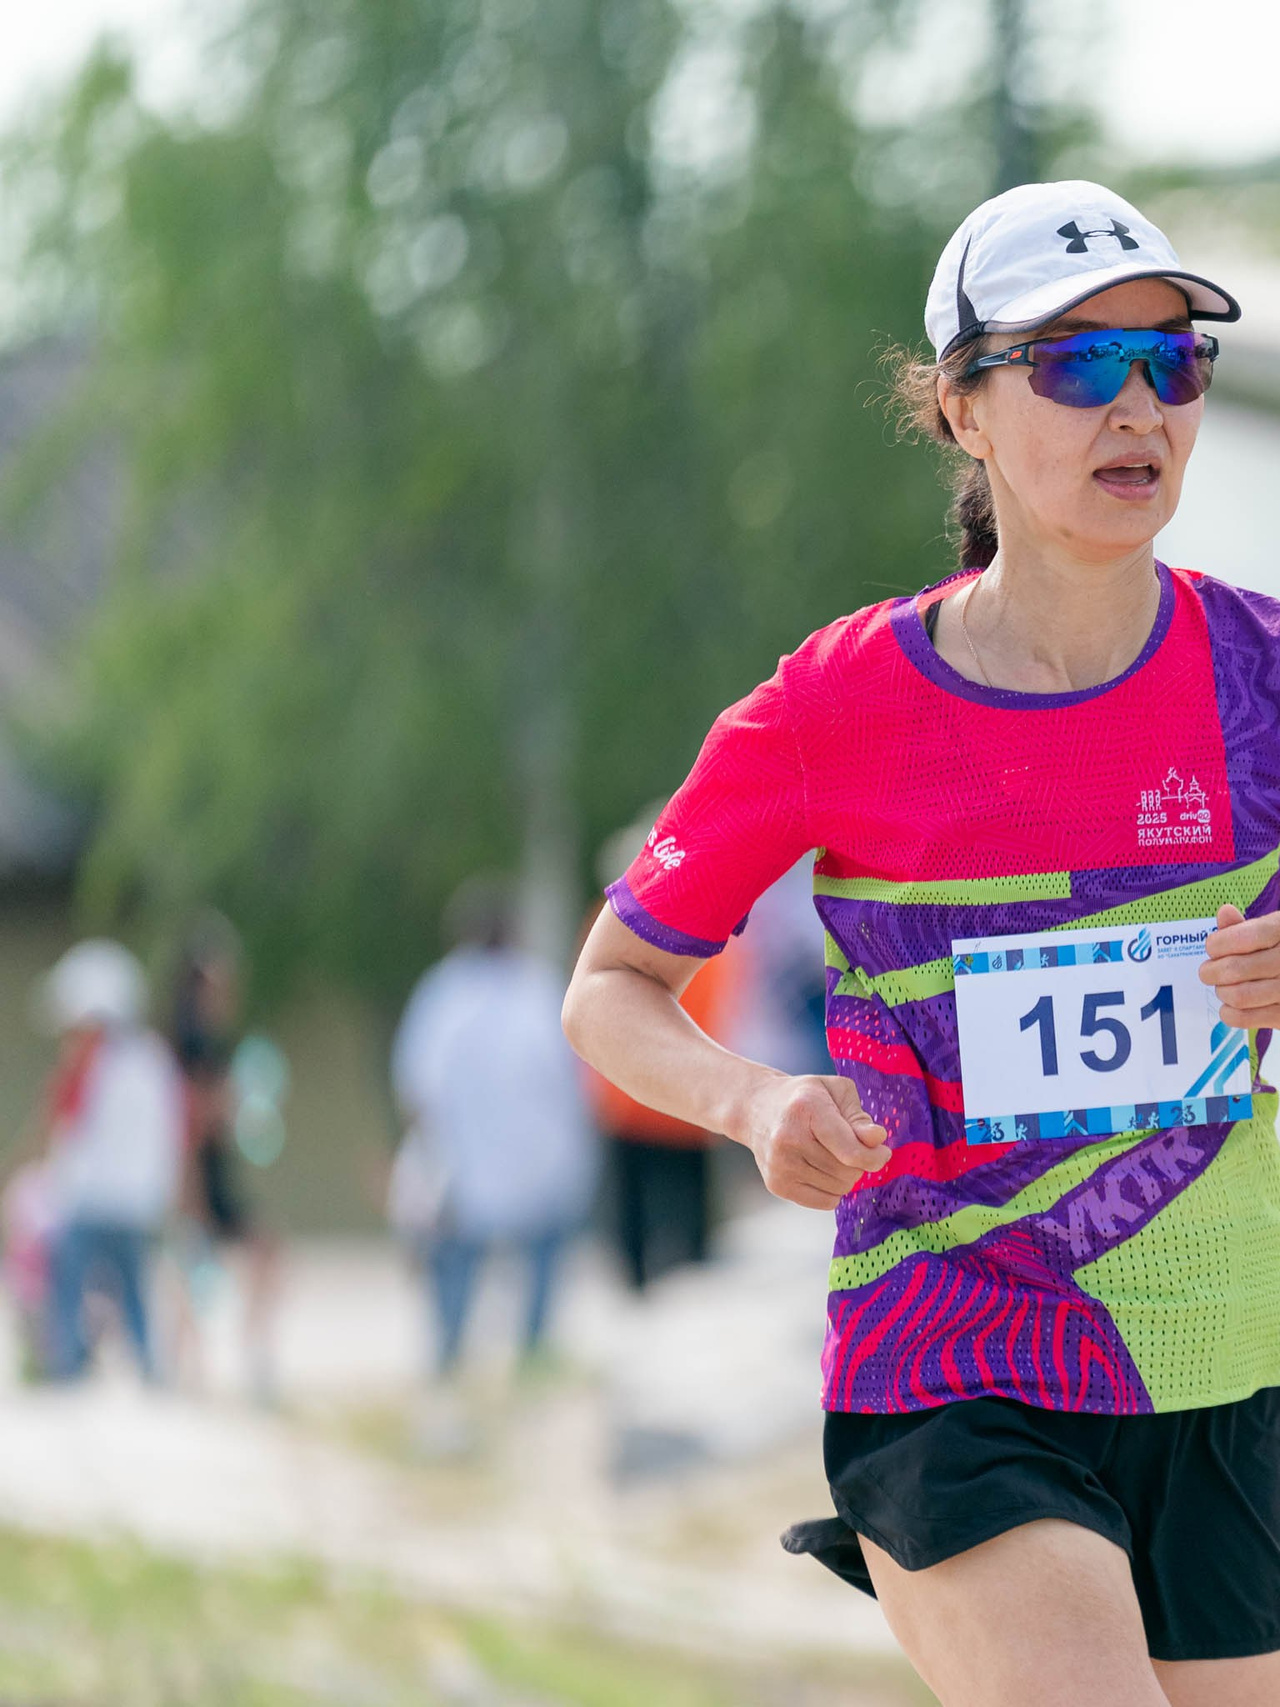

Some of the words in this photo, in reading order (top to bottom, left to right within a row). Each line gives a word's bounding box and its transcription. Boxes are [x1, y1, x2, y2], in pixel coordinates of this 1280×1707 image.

[1137, 812, 1167, 825] 2025
[1138, 824, 1212, 839] ЯКУТСКИЙ
[1138, 836, 1212, 847] ПОЛУМАРАФОН
[653, 836, 686, 870] life
[1156, 930, 1209, 946] ГОРНЫЙ
[1019, 984, 1179, 1077] 151
[1169, 1103, 1197, 1124] 23
[1035, 1126, 1205, 1259] YKTR
